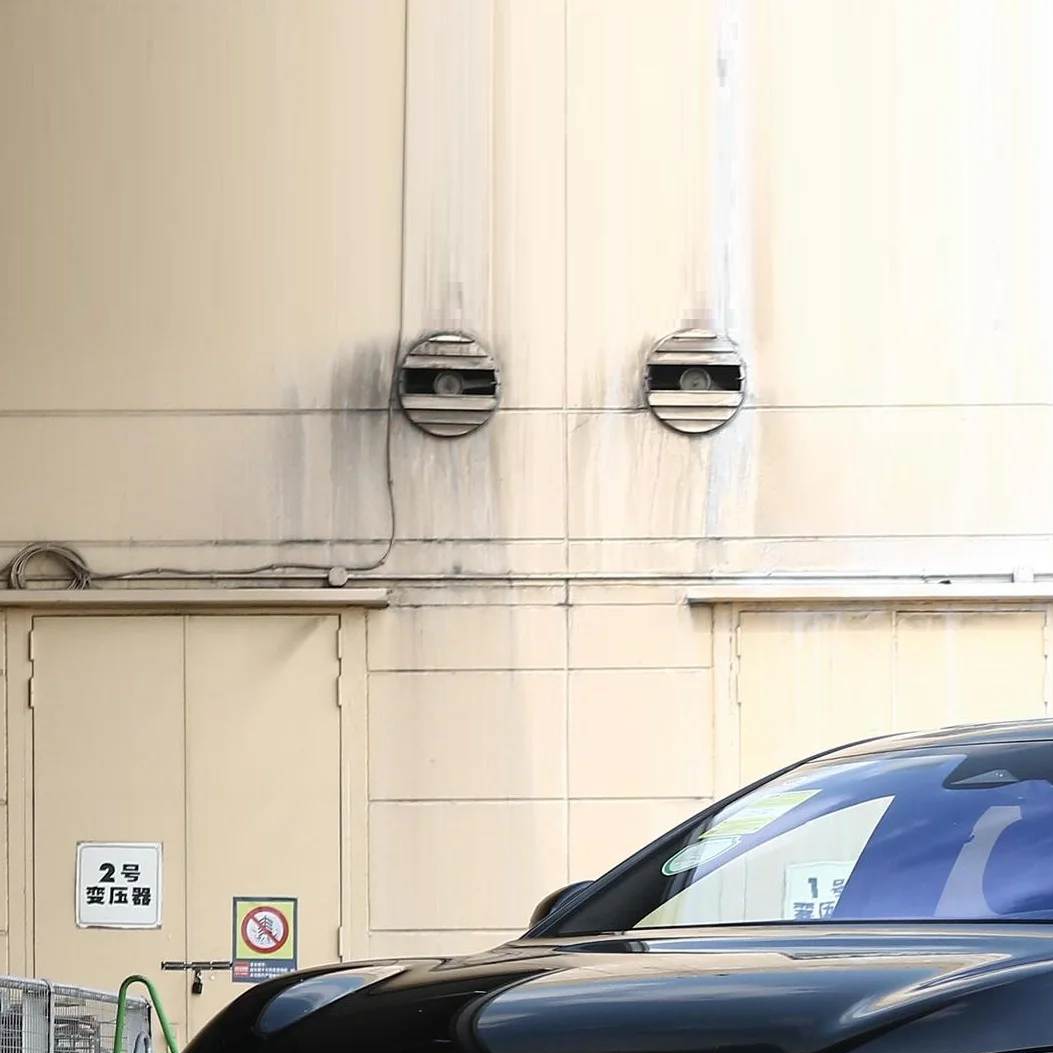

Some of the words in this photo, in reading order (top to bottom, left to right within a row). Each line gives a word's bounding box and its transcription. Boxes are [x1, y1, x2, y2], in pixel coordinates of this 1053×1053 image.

[99, 863, 141, 883] 2号
[86, 886, 151, 906] 变压器
